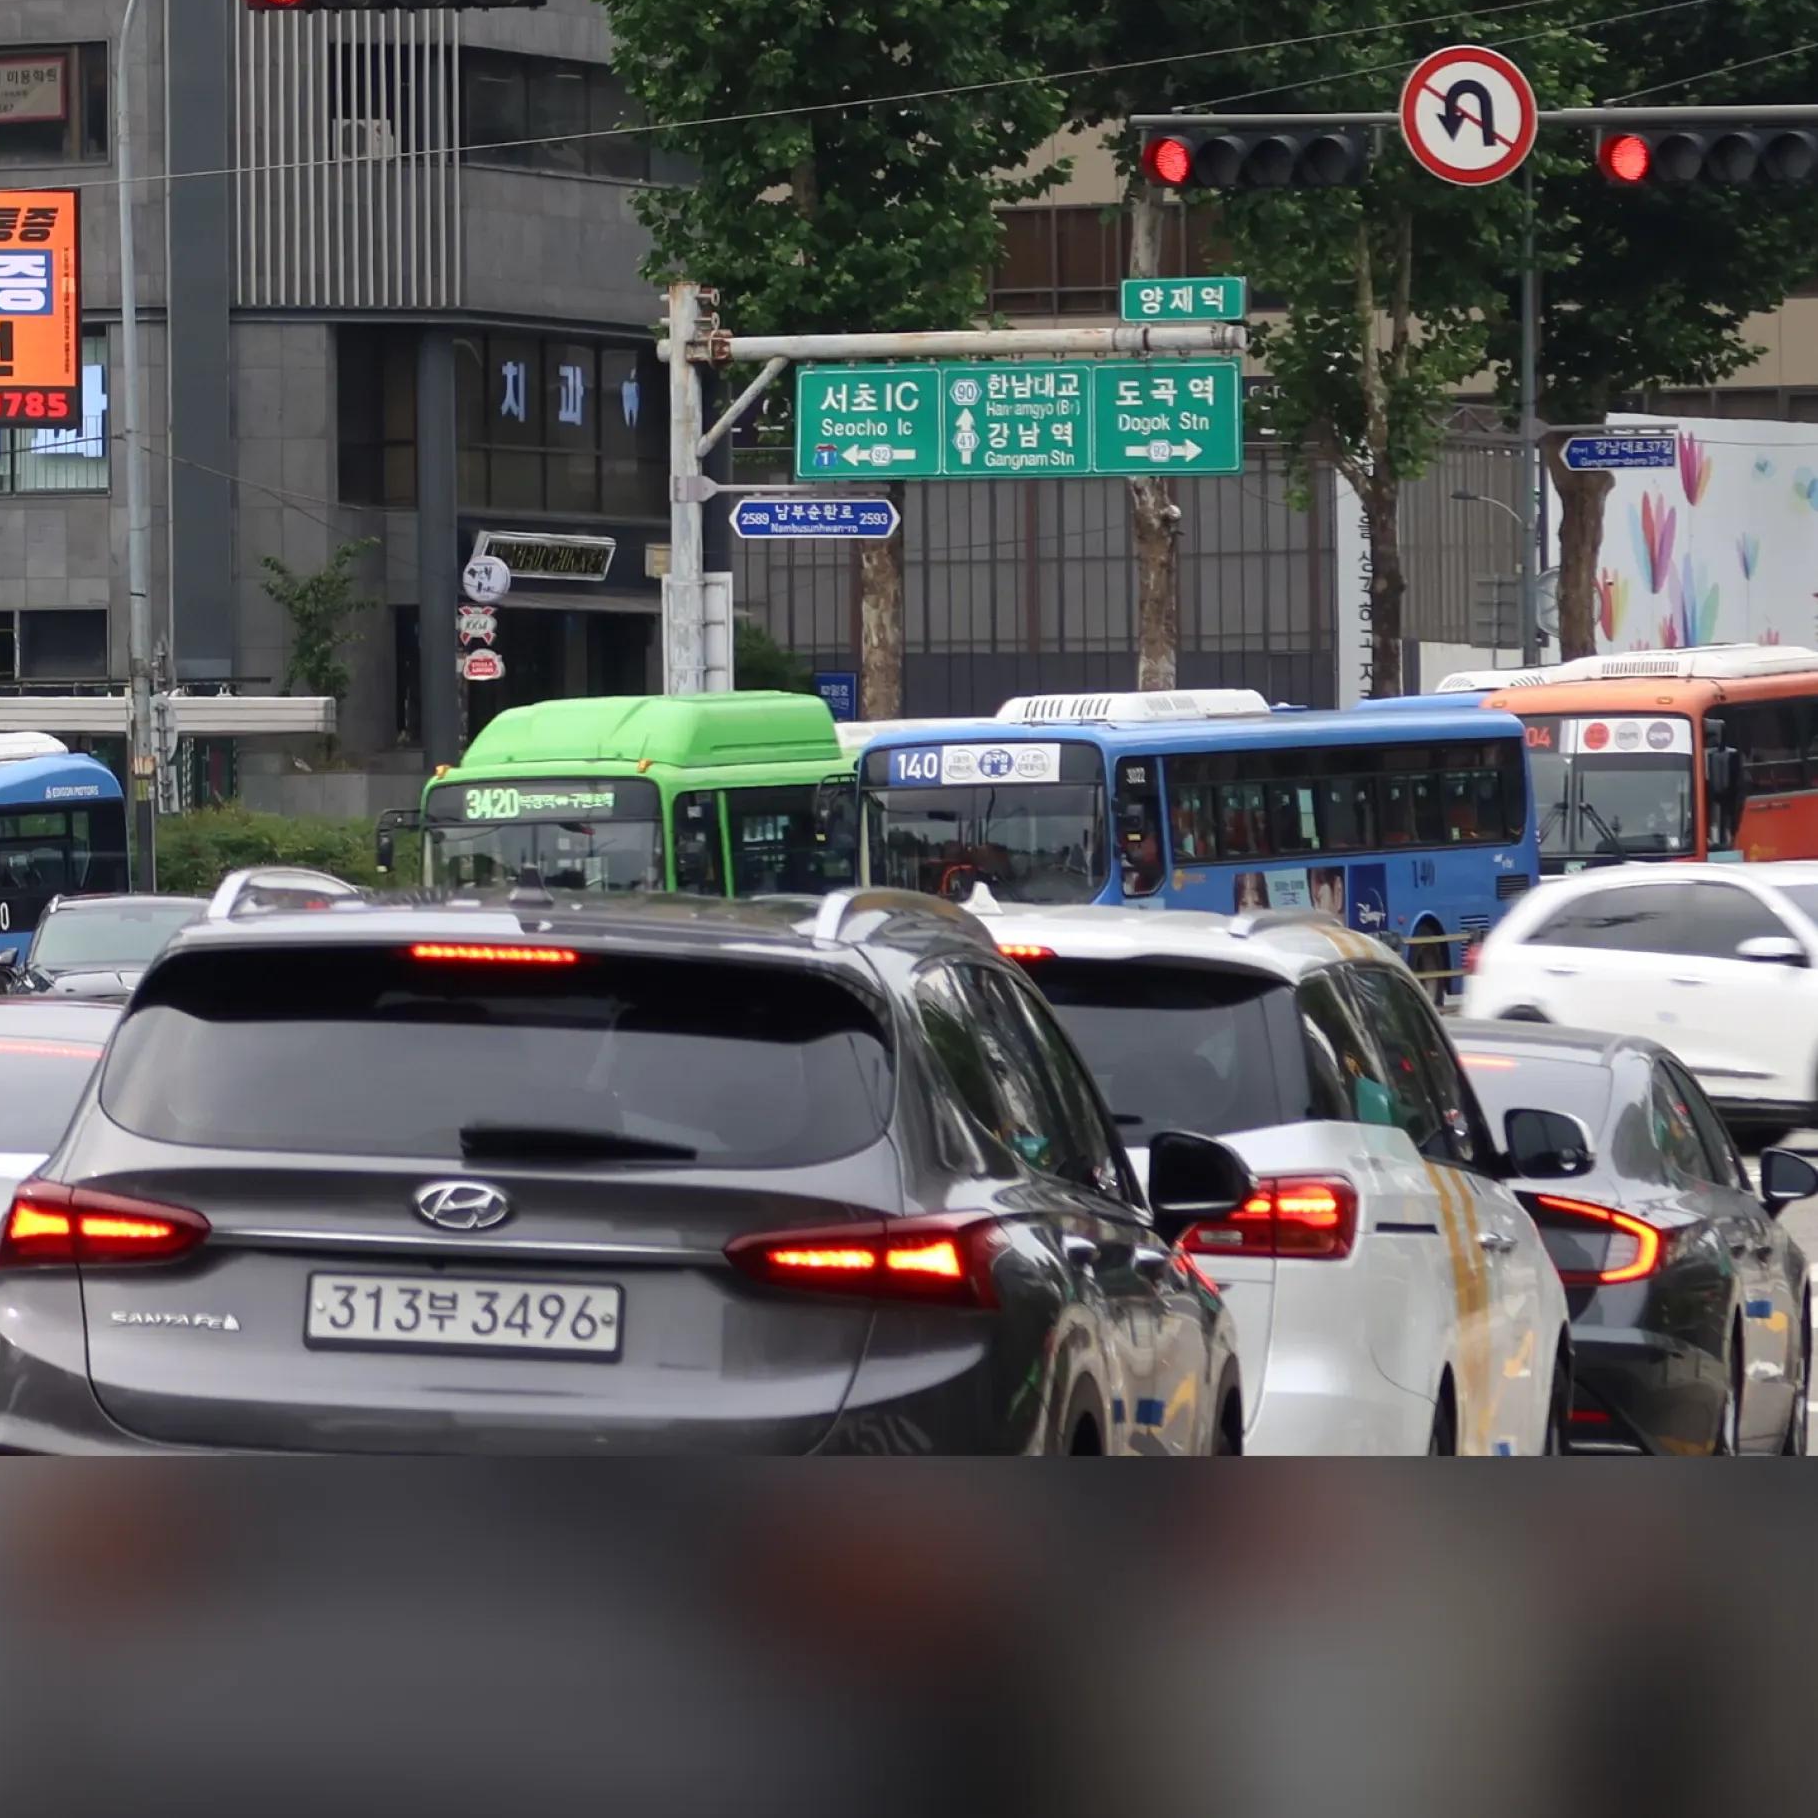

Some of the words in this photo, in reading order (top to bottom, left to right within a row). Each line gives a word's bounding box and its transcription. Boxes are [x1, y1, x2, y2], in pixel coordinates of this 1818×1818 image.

[1139, 285, 1225, 314] 양재역
[955, 384, 975, 400] 90
[987, 372, 1081, 399] 한남대교
[1115, 375, 1215, 407] 도곡역
[821, 417, 888, 436] Seocho
[987, 421, 1074, 449] 강남역
[1118, 413, 1171, 435] Dogok
[1178, 411, 1210, 431] Stn
[984, 450, 1049, 470] Gangnam
[1050, 448, 1076, 467] Stn
[741, 512, 770, 525] 2589
[774, 503, 855, 521] 남부순환로
[858, 512, 888, 525] 2593
[897, 752, 938, 781] 140
[466, 788, 519, 819] 3420
[328, 1283, 459, 1333] 313부
[470, 1288, 600, 1342] 3496
